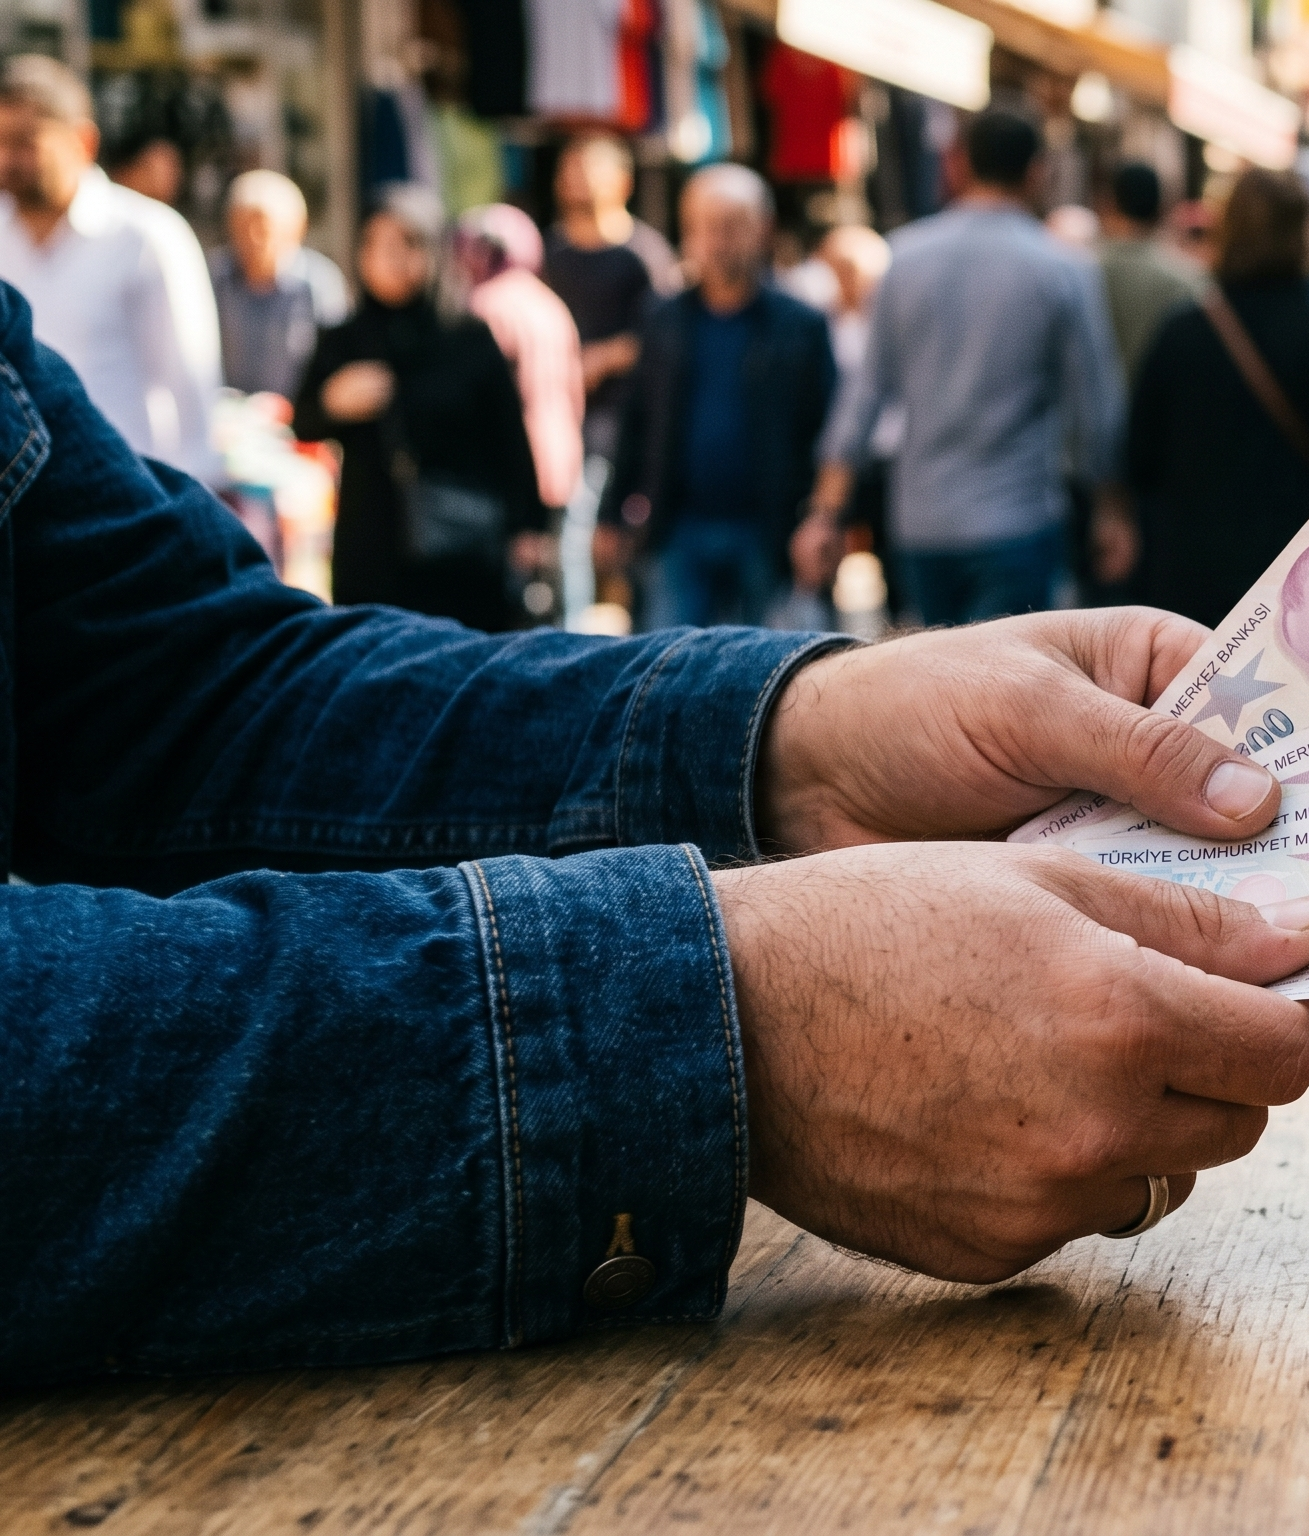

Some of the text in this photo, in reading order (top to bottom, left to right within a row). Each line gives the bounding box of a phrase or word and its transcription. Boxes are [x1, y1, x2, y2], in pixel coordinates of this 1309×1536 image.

[1170, 660, 1221, 719] MERKEZ
[1216, 603, 1272, 663] BANKASI
[1233, 708, 1294, 758] 00
[1098, 848, 1172, 865] TÜRKİYE
[1177, 836, 1291, 862] CUMHURİYET
